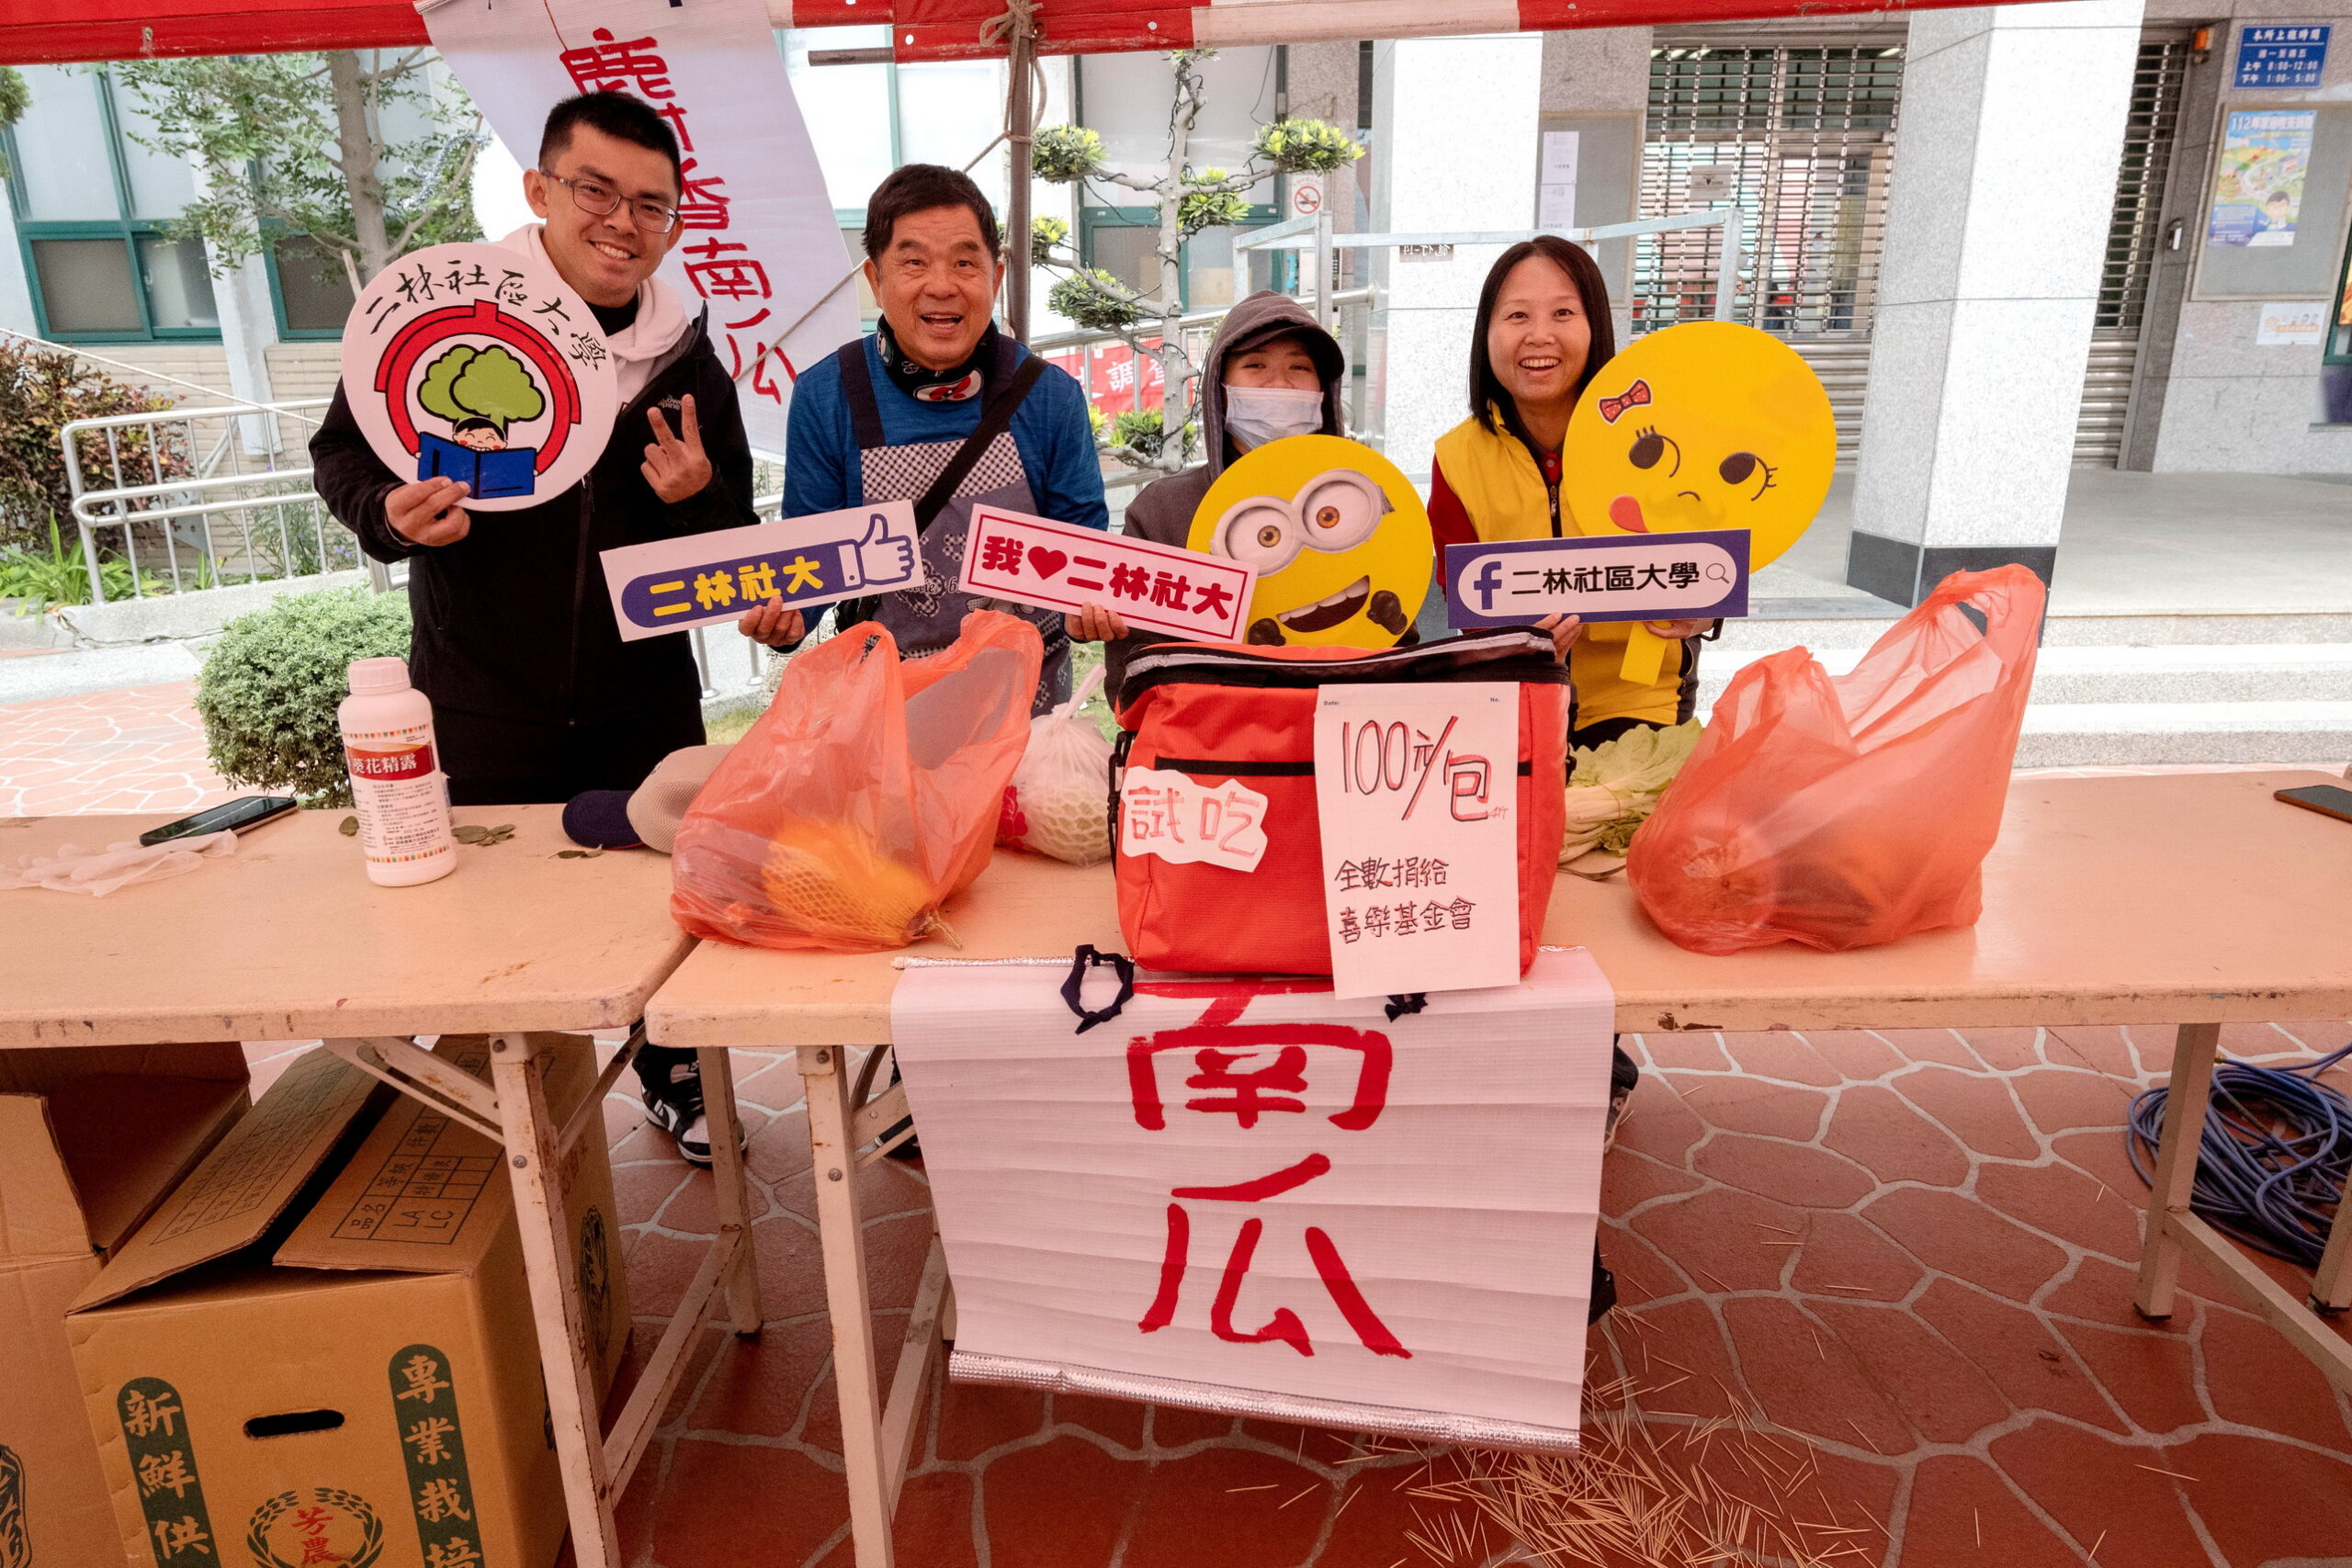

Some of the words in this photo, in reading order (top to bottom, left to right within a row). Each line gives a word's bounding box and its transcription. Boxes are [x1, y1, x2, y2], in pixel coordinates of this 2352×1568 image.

[2243, 73, 2259, 84] 下午
[2244, 62, 2262, 72] 上午
[366, 260, 606, 370] 二林社區大學
[650, 556, 824, 617] 二林社大
[982, 536, 1024, 576] 我
[1067, 555, 1234, 620] 二林社大
[1511, 561, 1700, 595] 二林社區大學
[1128, 786, 1261, 858] 試吃
[1334, 856, 1450, 892] 全數捐給
[1339, 896, 1476, 944] 喜樂基金會
[1126, 976, 1413, 1359] 南瓜
[349, 1202, 386, 1230] 品名
[125, 1389, 210, 1560] 新鮮供
[396, 1355, 482, 1568] 專業栽培
[291, 1506, 344, 1567] 芳農
